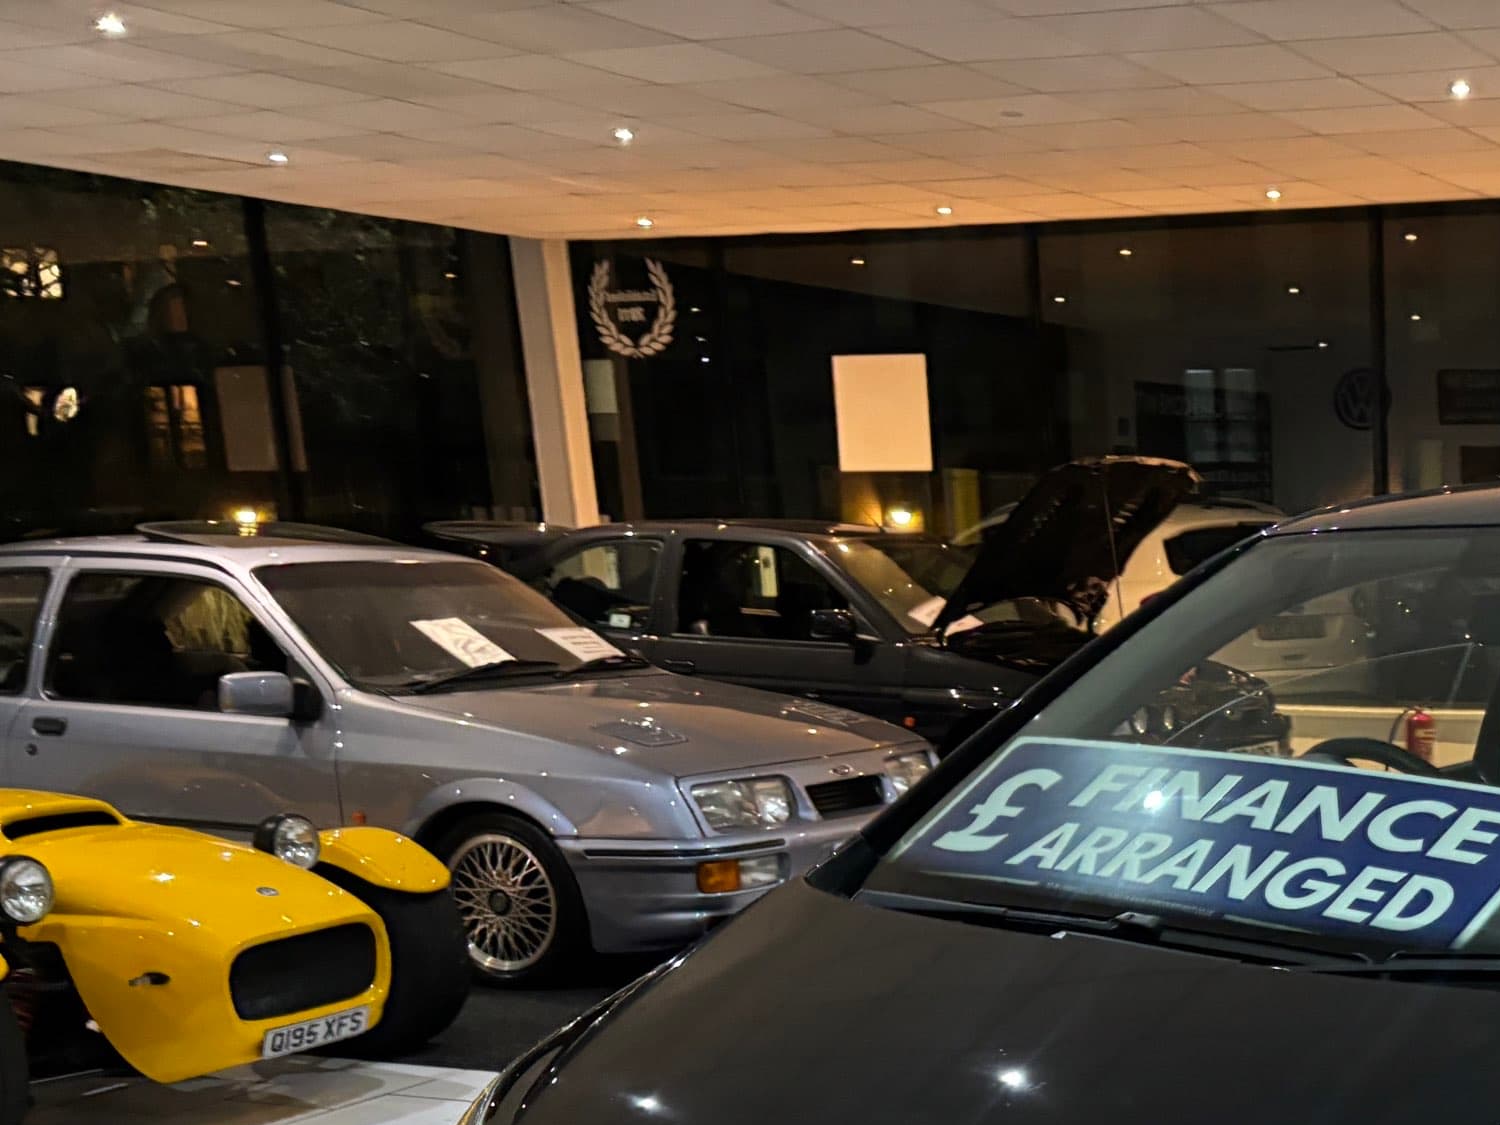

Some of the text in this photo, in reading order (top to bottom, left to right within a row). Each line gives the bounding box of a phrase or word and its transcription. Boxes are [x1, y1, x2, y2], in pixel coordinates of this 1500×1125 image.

[933, 768, 1062, 852] £
[1006, 823, 1456, 932] ARRANGED
[323, 1011, 364, 1039] XFS
